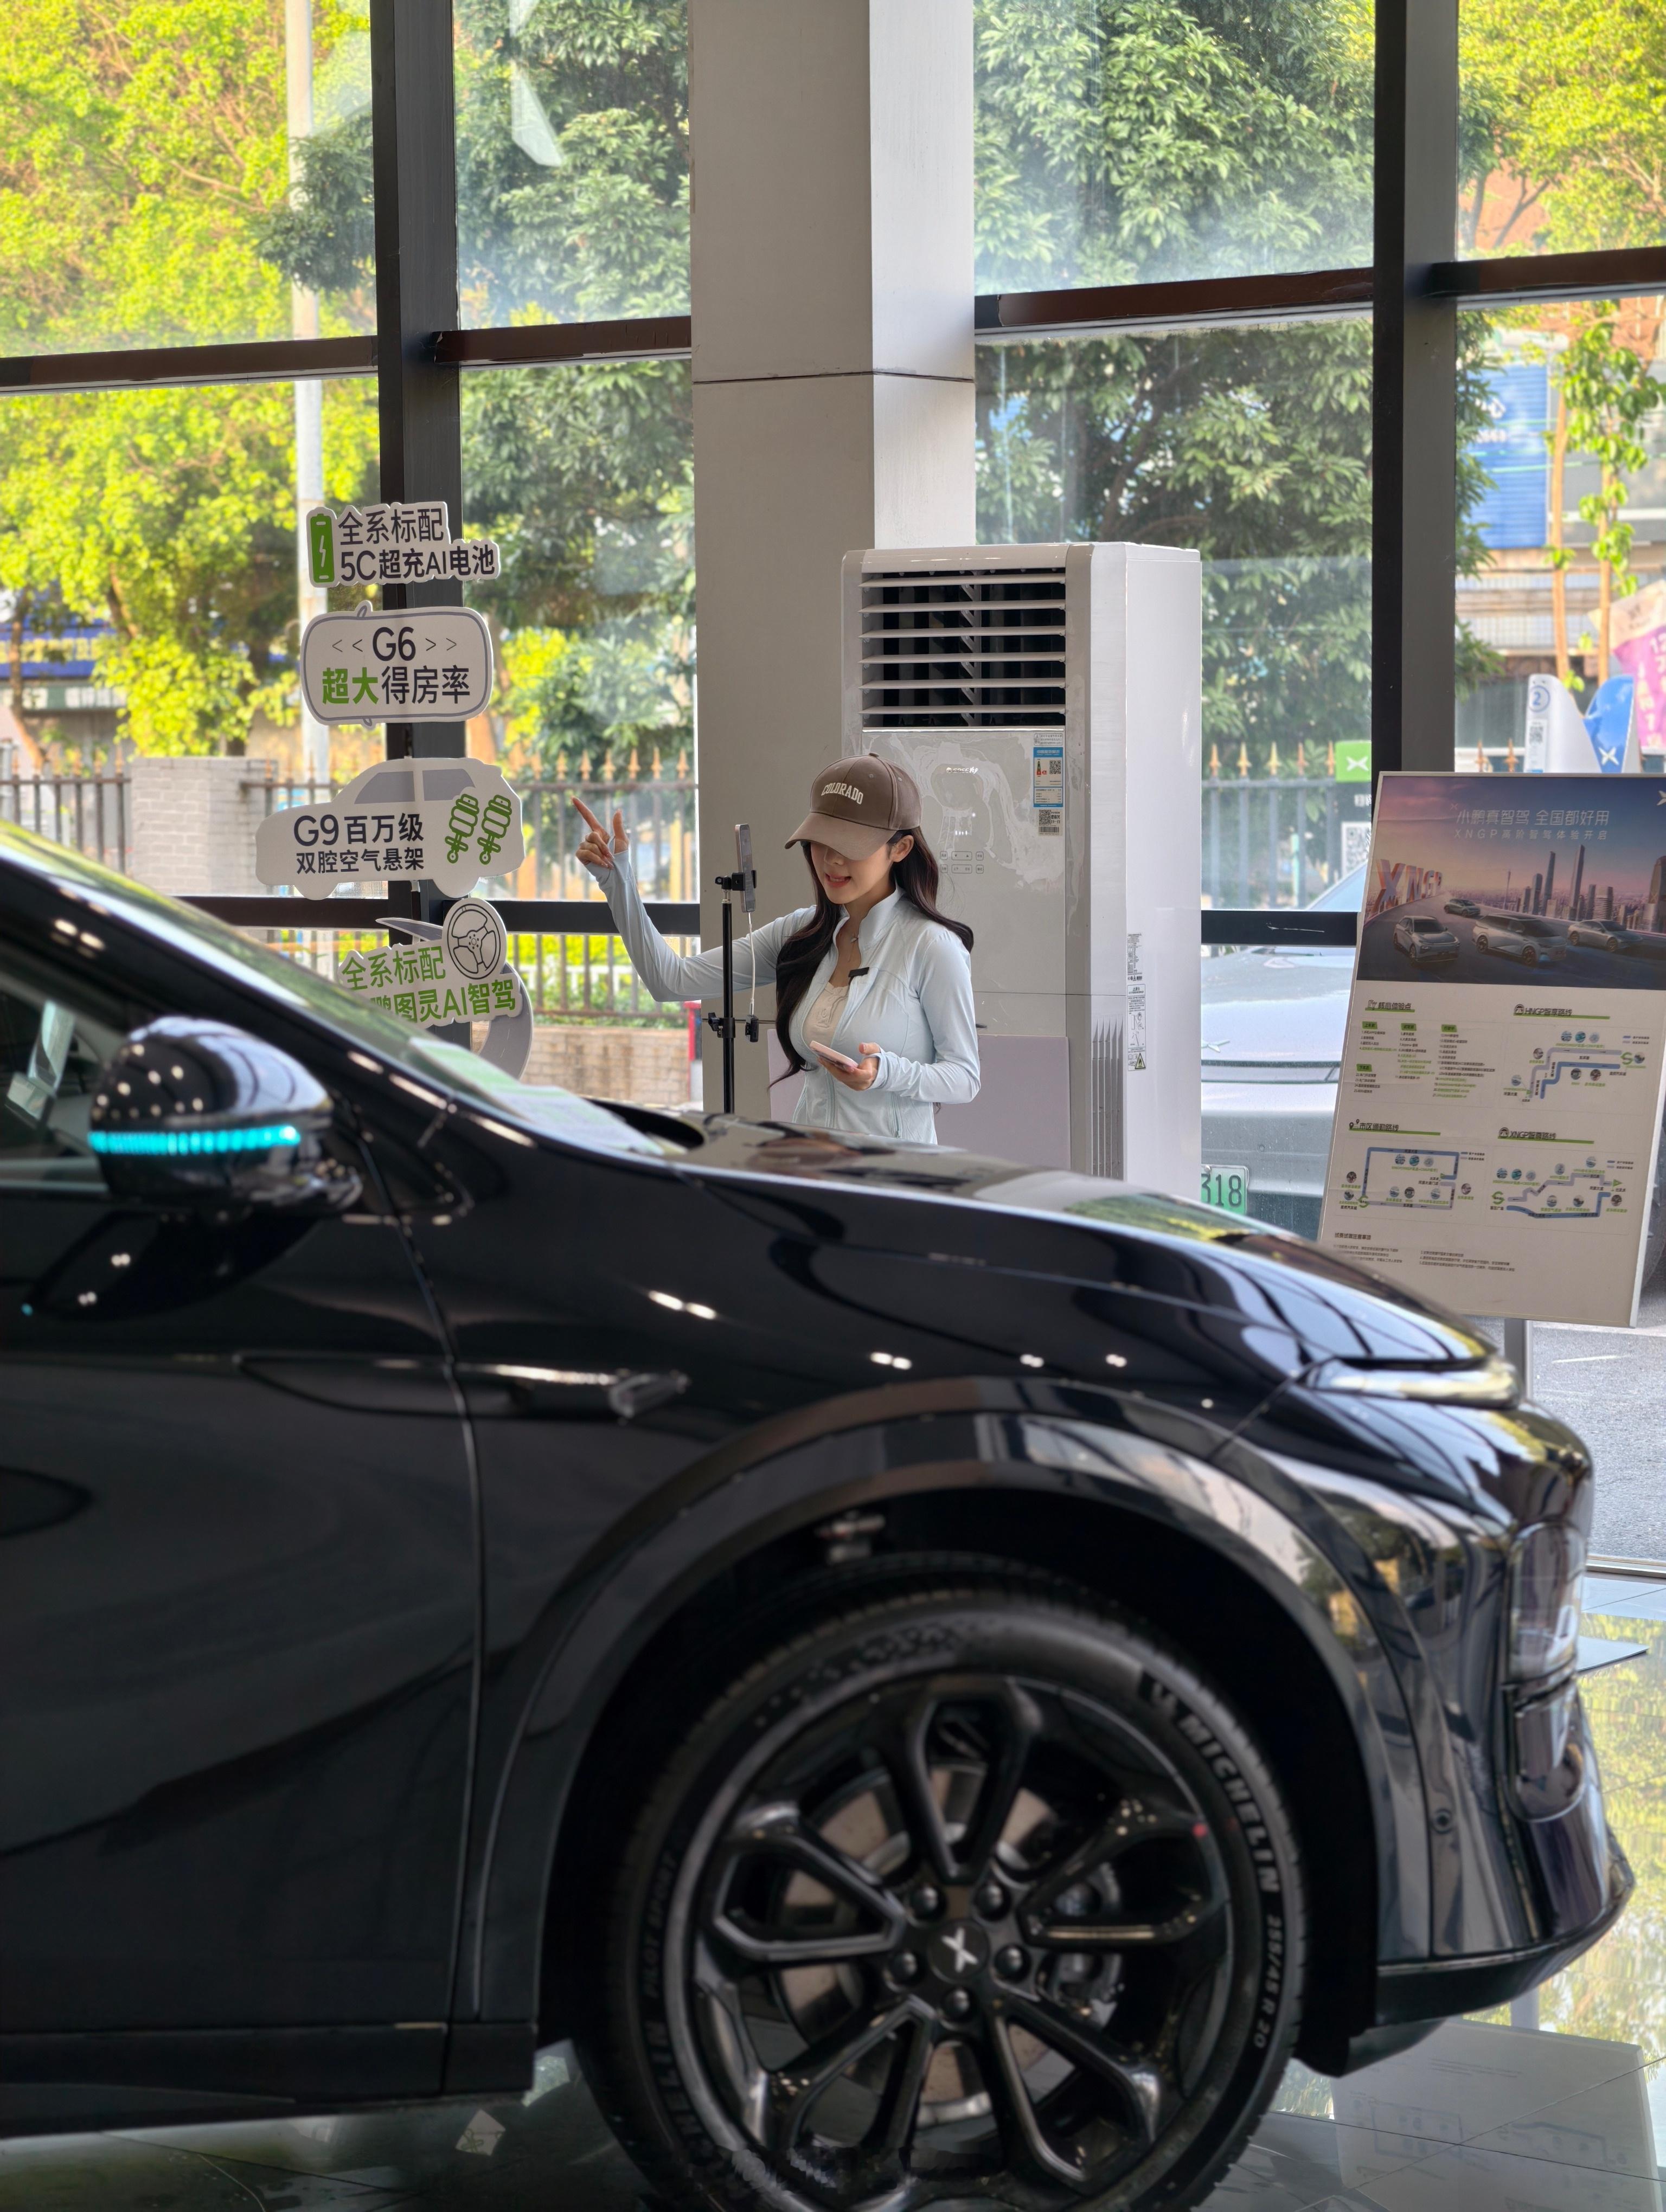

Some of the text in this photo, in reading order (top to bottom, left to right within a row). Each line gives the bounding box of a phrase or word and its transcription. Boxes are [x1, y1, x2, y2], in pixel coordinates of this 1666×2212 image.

[337, 507, 444, 545] 全系标配
[341, 545, 496, 582] 5C超充AI电池
[371, 626, 416, 661] G6
[322, 665, 470, 705] 超大得房率
[1532, 691, 1541, 706] 2
[821, 782, 863, 805] COLORADO
[1456, 809, 1609, 826] 小鹏真智驾 全国都好用
[296, 847, 424, 875] 双腔空气悬架
[1372, 859, 1443, 915] XNGP
[342, 946, 446, 992] 全系标配
[1201, 1173, 1242, 1206] 318
[1178, 1715, 1280, 1892] MICHELIN
